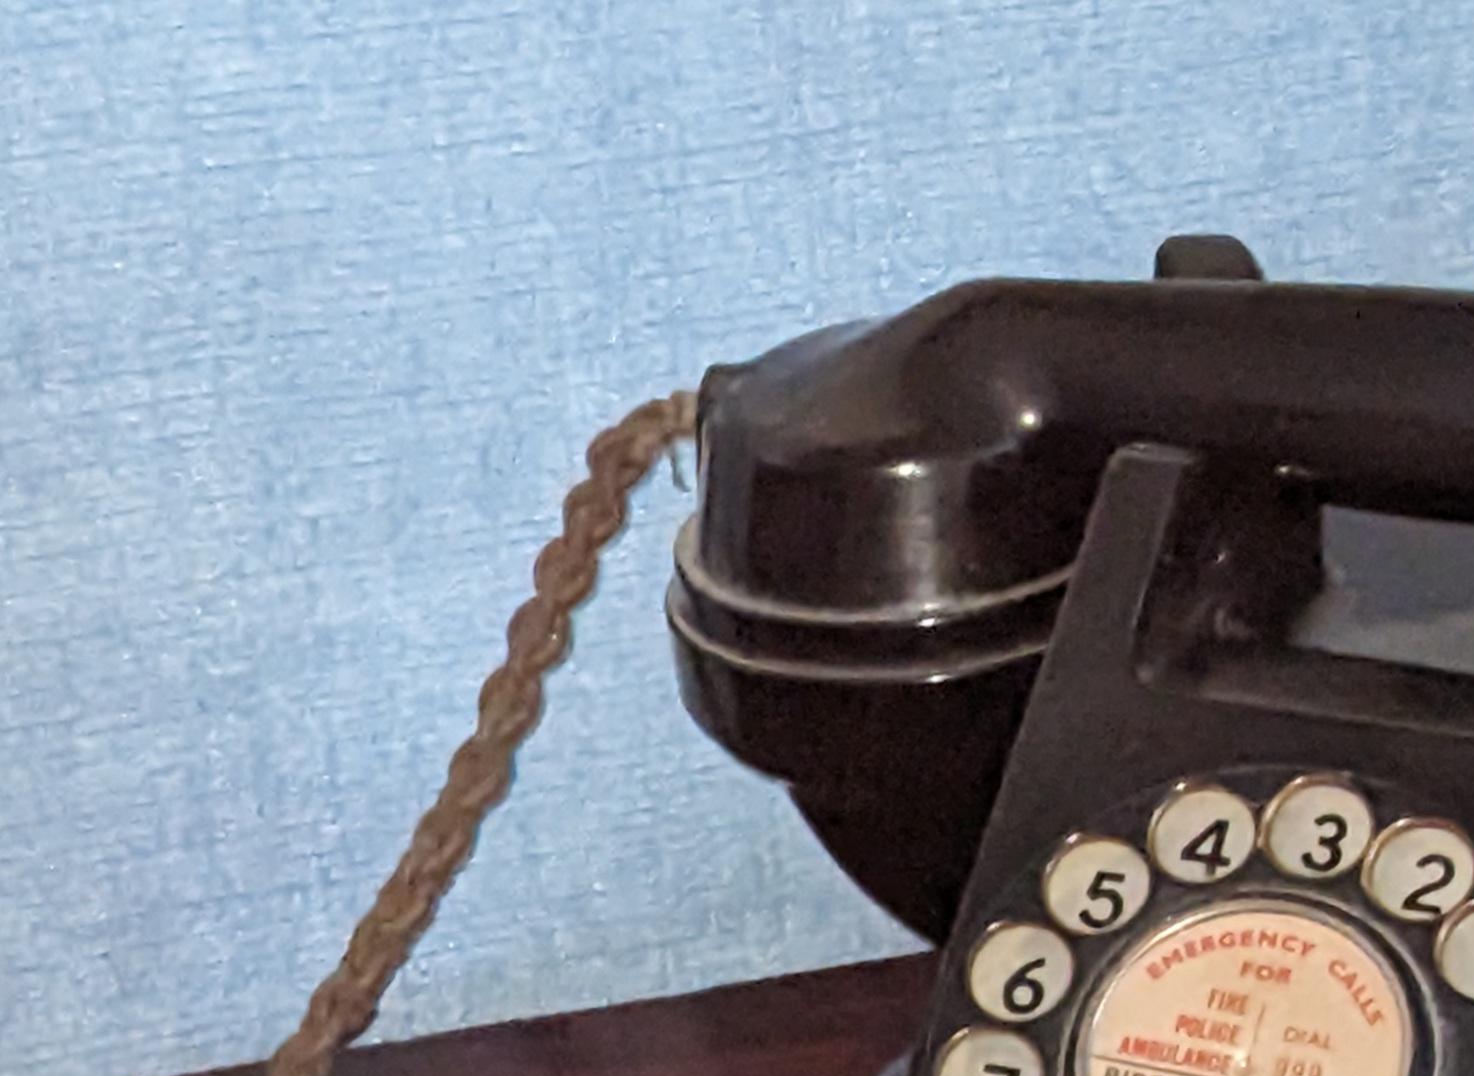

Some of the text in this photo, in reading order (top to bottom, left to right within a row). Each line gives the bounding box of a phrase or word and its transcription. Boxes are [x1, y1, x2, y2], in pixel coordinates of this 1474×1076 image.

[1180, 819, 1231, 876] 4
[1301, 814, 1348, 871] 3
[1079, 871, 1125, 928] 5
[1401, 854, 1456, 916] 2
[1003, 957, 1046, 1014] 6
[1146, 929, 1386, 1026] EMERGENCY CALLS
[1239, 961, 1292, 984] FOR
[1175, 1014, 1242, 1044] POLICE
[1207, 988, 1249, 1015] FIRE
[1117, 1036, 1233, 1074] AMBULANCE
[1283, 1026, 1331, 1049] DIAL
